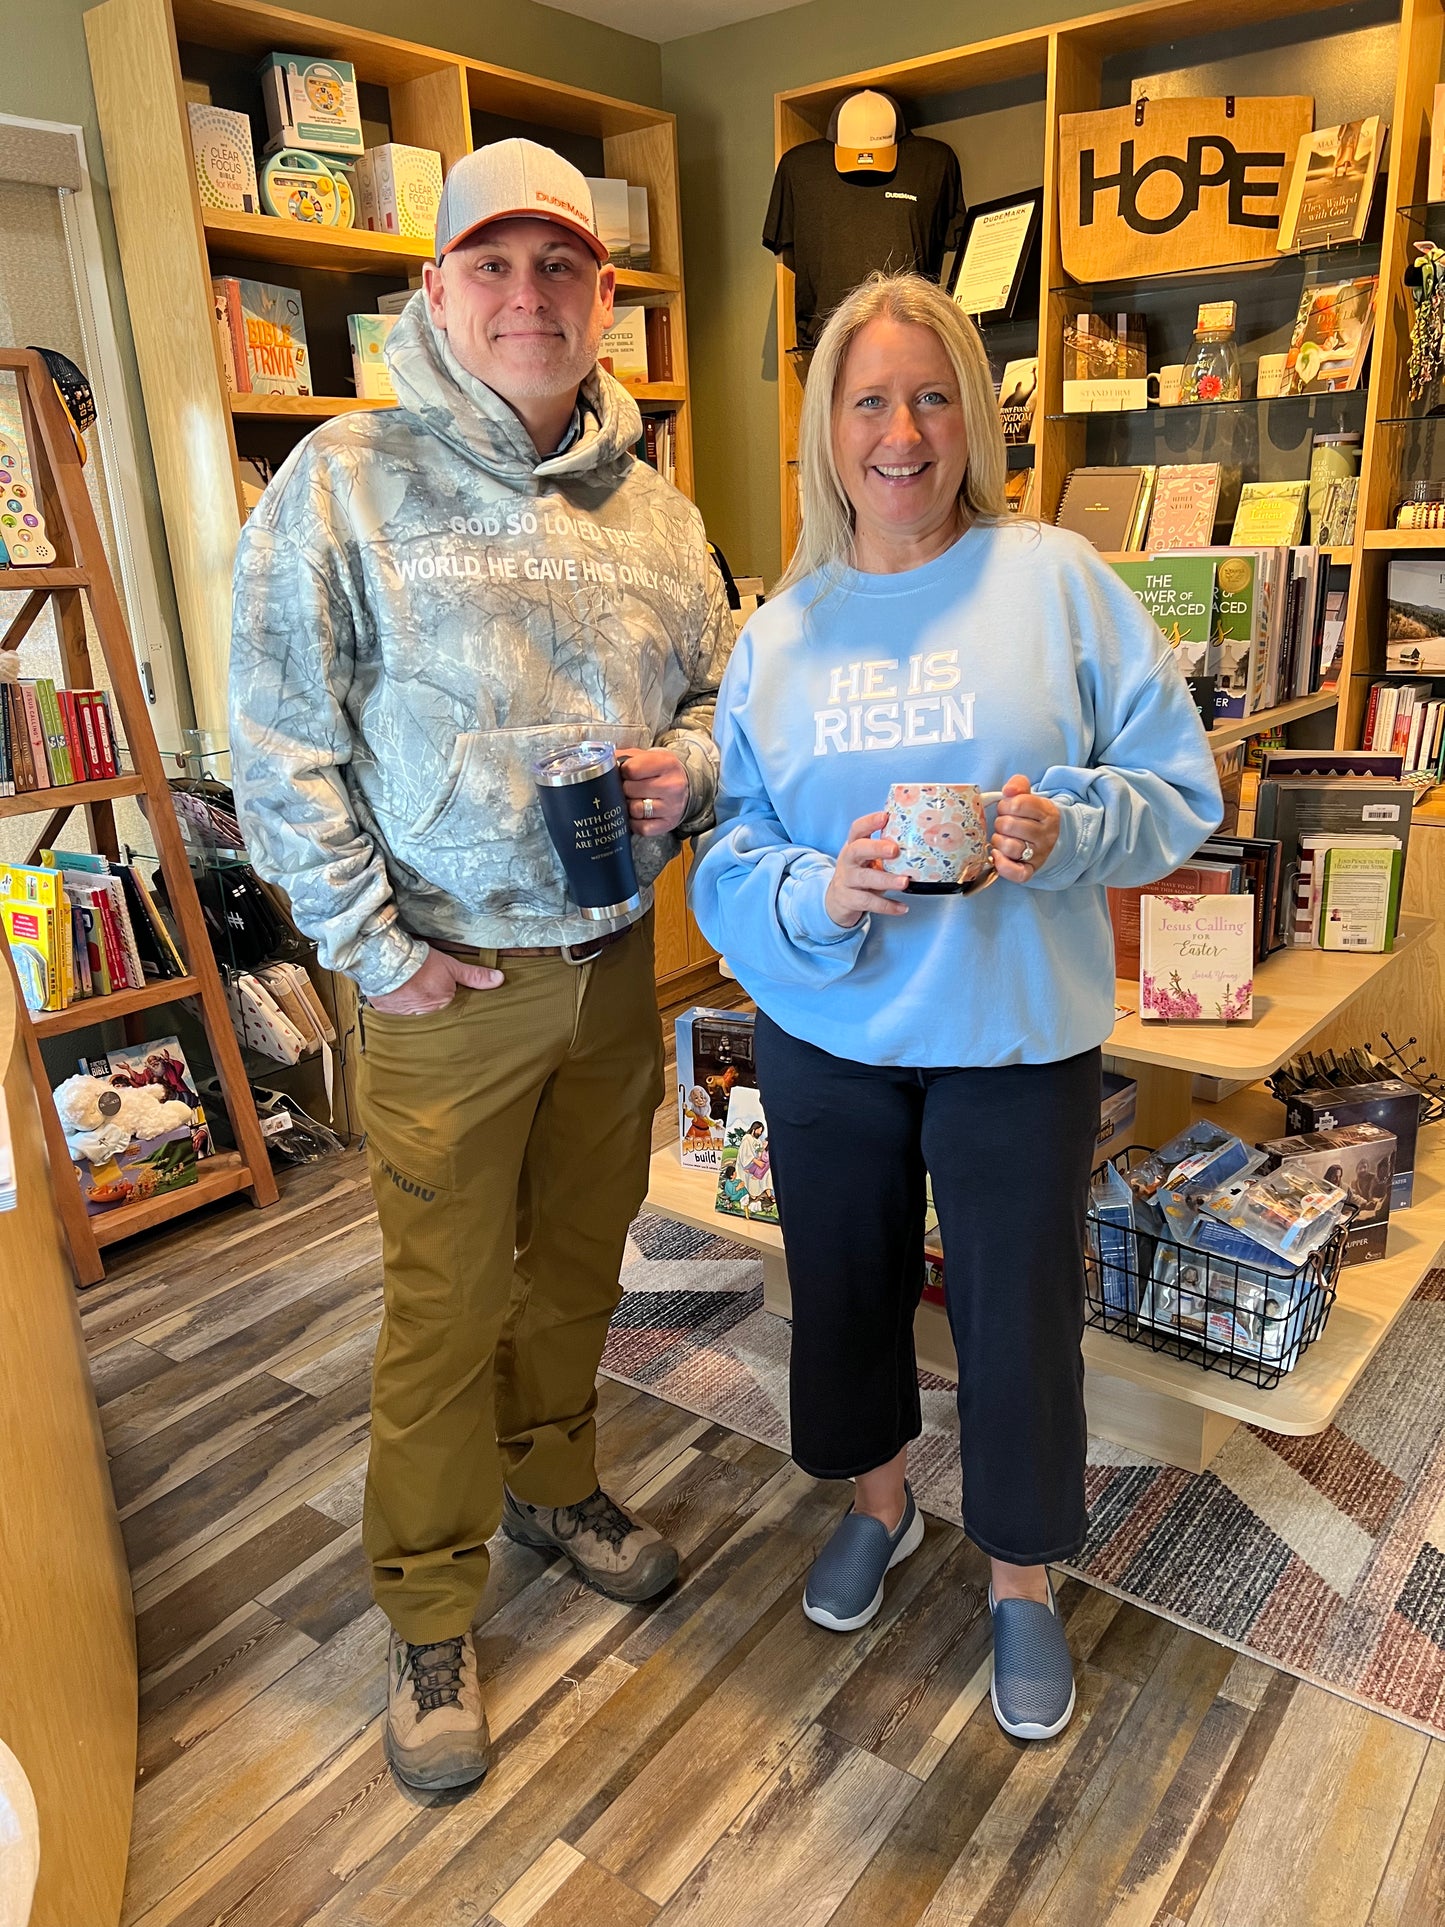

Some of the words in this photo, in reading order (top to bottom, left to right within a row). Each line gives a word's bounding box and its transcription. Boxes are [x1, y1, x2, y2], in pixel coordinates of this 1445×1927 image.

[210, 147, 240, 162] CLEAR
[210, 158, 242, 174] FOCUS
[220, 172, 235, 180] BIBLE
[216, 178, 226, 188] for
[227, 180, 242, 192] Kids
[408, 183, 432, 196] CLEAR
[1079, 135, 1286, 235] HOPE
[409, 193, 434, 206] FOCUS
[1302, 202, 1322, 214] They
[1326, 192, 1358, 209] Walked
[416, 204, 428, 212] BIBLE
[1308, 210, 1327, 221] with
[1329, 205, 1348, 217] God
[246, 319, 293, 348] BIBLE
[250, 344, 296, 378] TRIVIA
[79, 402, 87, 416] SO
[1257, 500, 1281, 510] Jesus
[1250, 509, 1284, 520] Listens
[450, 516, 500, 536] GOD
[506, 512, 538, 536] SO
[544, 512, 602, 542] LOVED
[601, 526, 641, 548] THE
[393, 556, 481, 582] WORLD
[487, 557, 518, 579] HE
[524, 558, 578, 581] GAVE
[582, 560, 616, 582] HIS
[618, 564, 659, 590] ONLY
[1146, 575, 1172, 588] THE
[1133, 590, 1176, 603] OWER
[1180, 592, 1193, 600] OF
[1148, 604, 1206, 616] -PLACED
[1212, 602, 1248, 614] ACED
[828, 659, 898, 704] HE
[908, 650, 961, 696] IS
[26, 691, 34, 711] JESUS
[30, 711, 38, 737] CALLING
[814, 692, 976, 756] RISEN
[574, 815, 602, 828] WITH
[604, 806, 622, 820] GOD
[576, 829, 592, 839] ALL
[593, 816, 624, 835] THINGS
[576, 840, 592, 849] ARE
[1158, 918, 1191, 932] Jesus
[1196, 917, 1244, 936] Calling
[1173, 941, 1228, 957] Easter
[1192, 970, 1213, 980] Sarah
[1216, 970, 1240, 982] Young
[91, 1065, 110, 1076] BIBLE
[683, 1136, 724, 1156] NOAH
[695, 1151, 716, 1164] build
